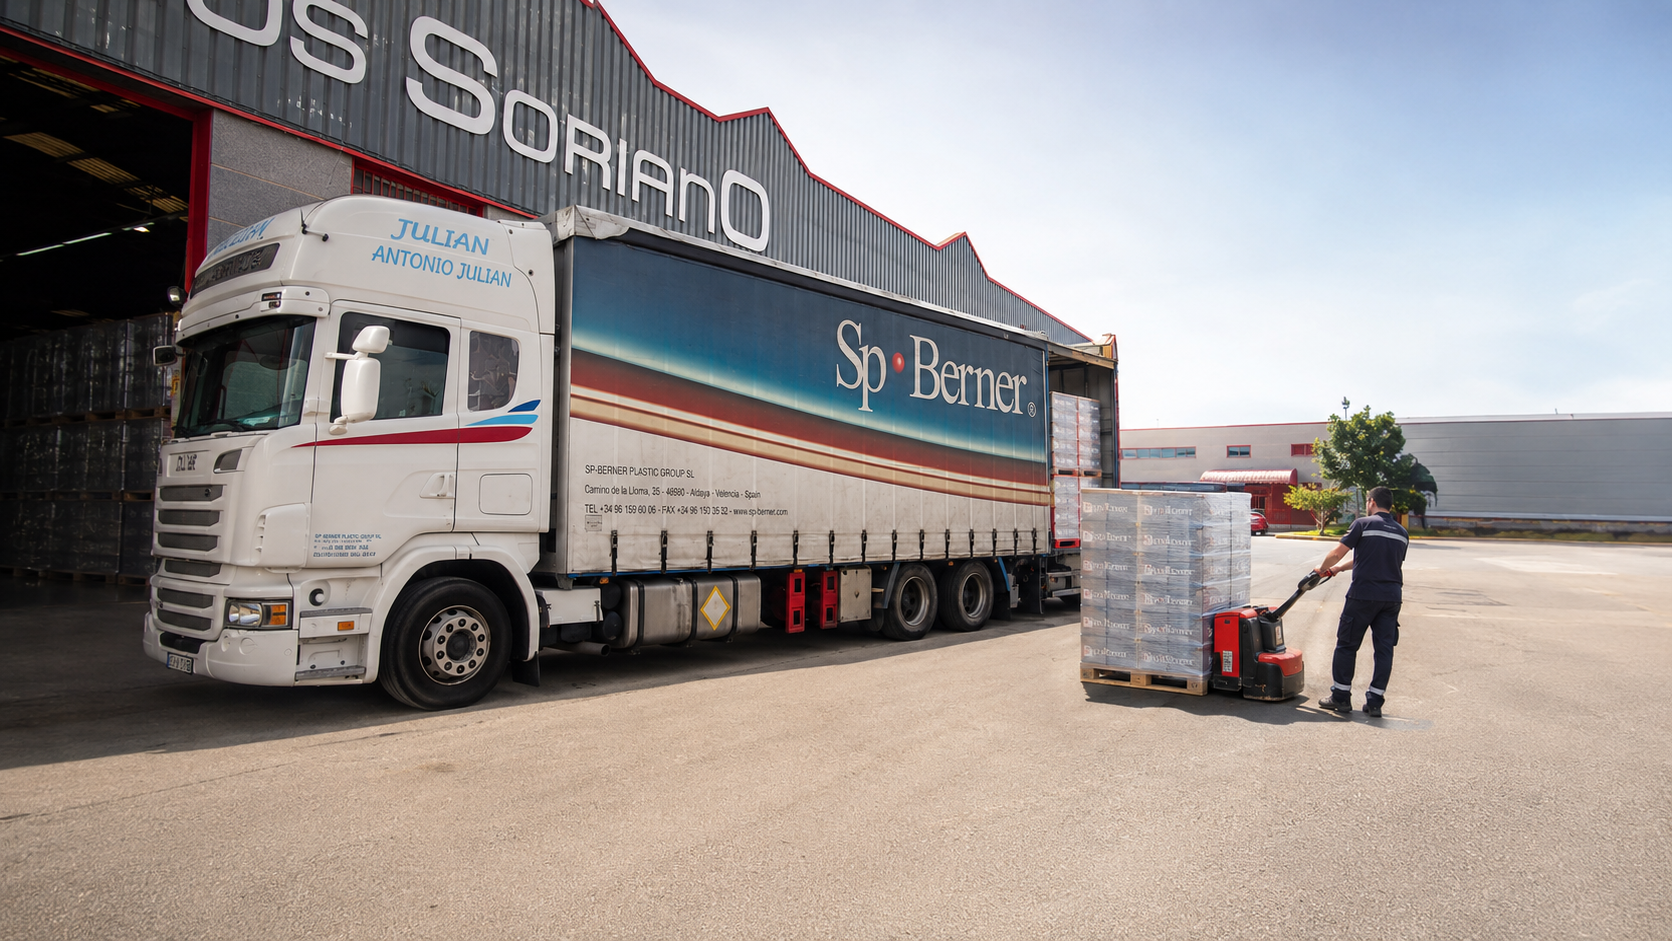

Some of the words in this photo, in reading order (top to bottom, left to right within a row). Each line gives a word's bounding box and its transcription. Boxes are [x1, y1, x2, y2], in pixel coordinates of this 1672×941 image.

[390, 218, 489, 256] JULIAN
[371, 245, 454, 276] ANTONIO
[456, 262, 512, 288] JULIAN
[909, 334, 1027, 414] Berner
[629, 466, 659, 477] PLASTIC
[660, 468, 685, 478] GROUP
[686, 469, 695, 479] SL
[584, 484, 610, 495] Camino
[611, 485, 620, 495] de
[621, 485, 628, 495] la
[584, 504, 598, 514] TEL
[661, 506, 675, 514] FAX
